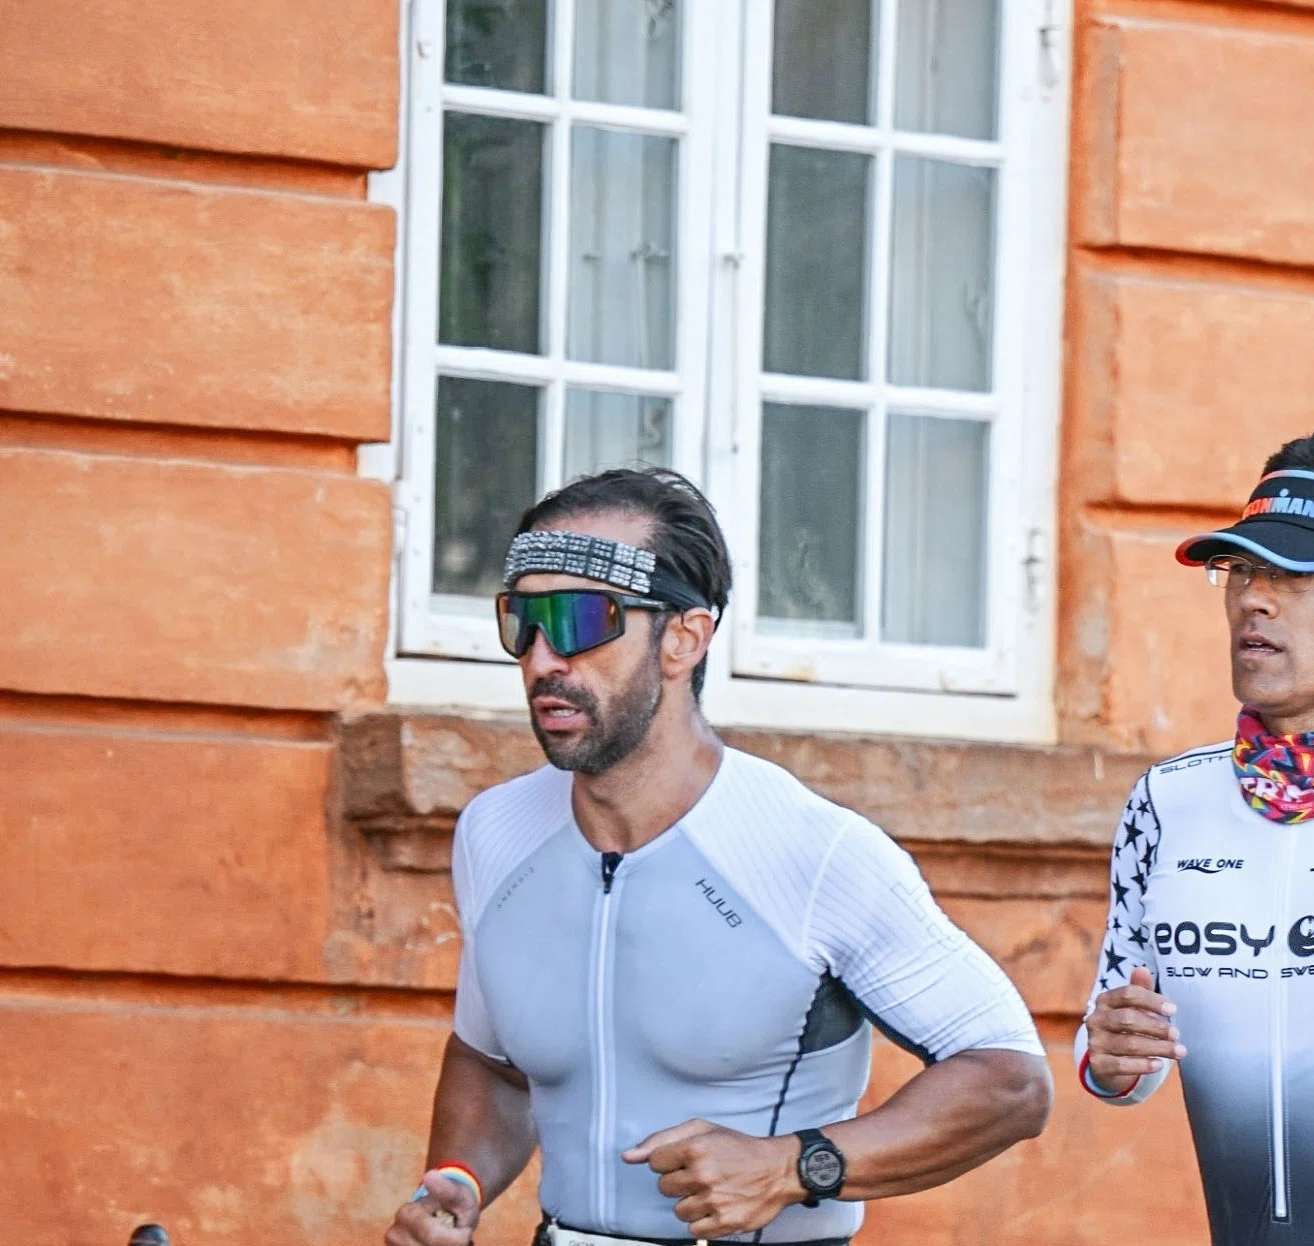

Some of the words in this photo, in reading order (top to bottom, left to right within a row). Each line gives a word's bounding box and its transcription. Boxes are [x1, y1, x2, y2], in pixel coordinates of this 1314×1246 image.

[1177, 858, 1211, 871] WAVE
[1217, 858, 1244, 870] ONE
[695, 878, 743, 928] HUUB
[1154, 920, 1276, 957] easy
[1167, 965, 1213, 978] SLOW
[1218, 967, 1269, 979] AND
